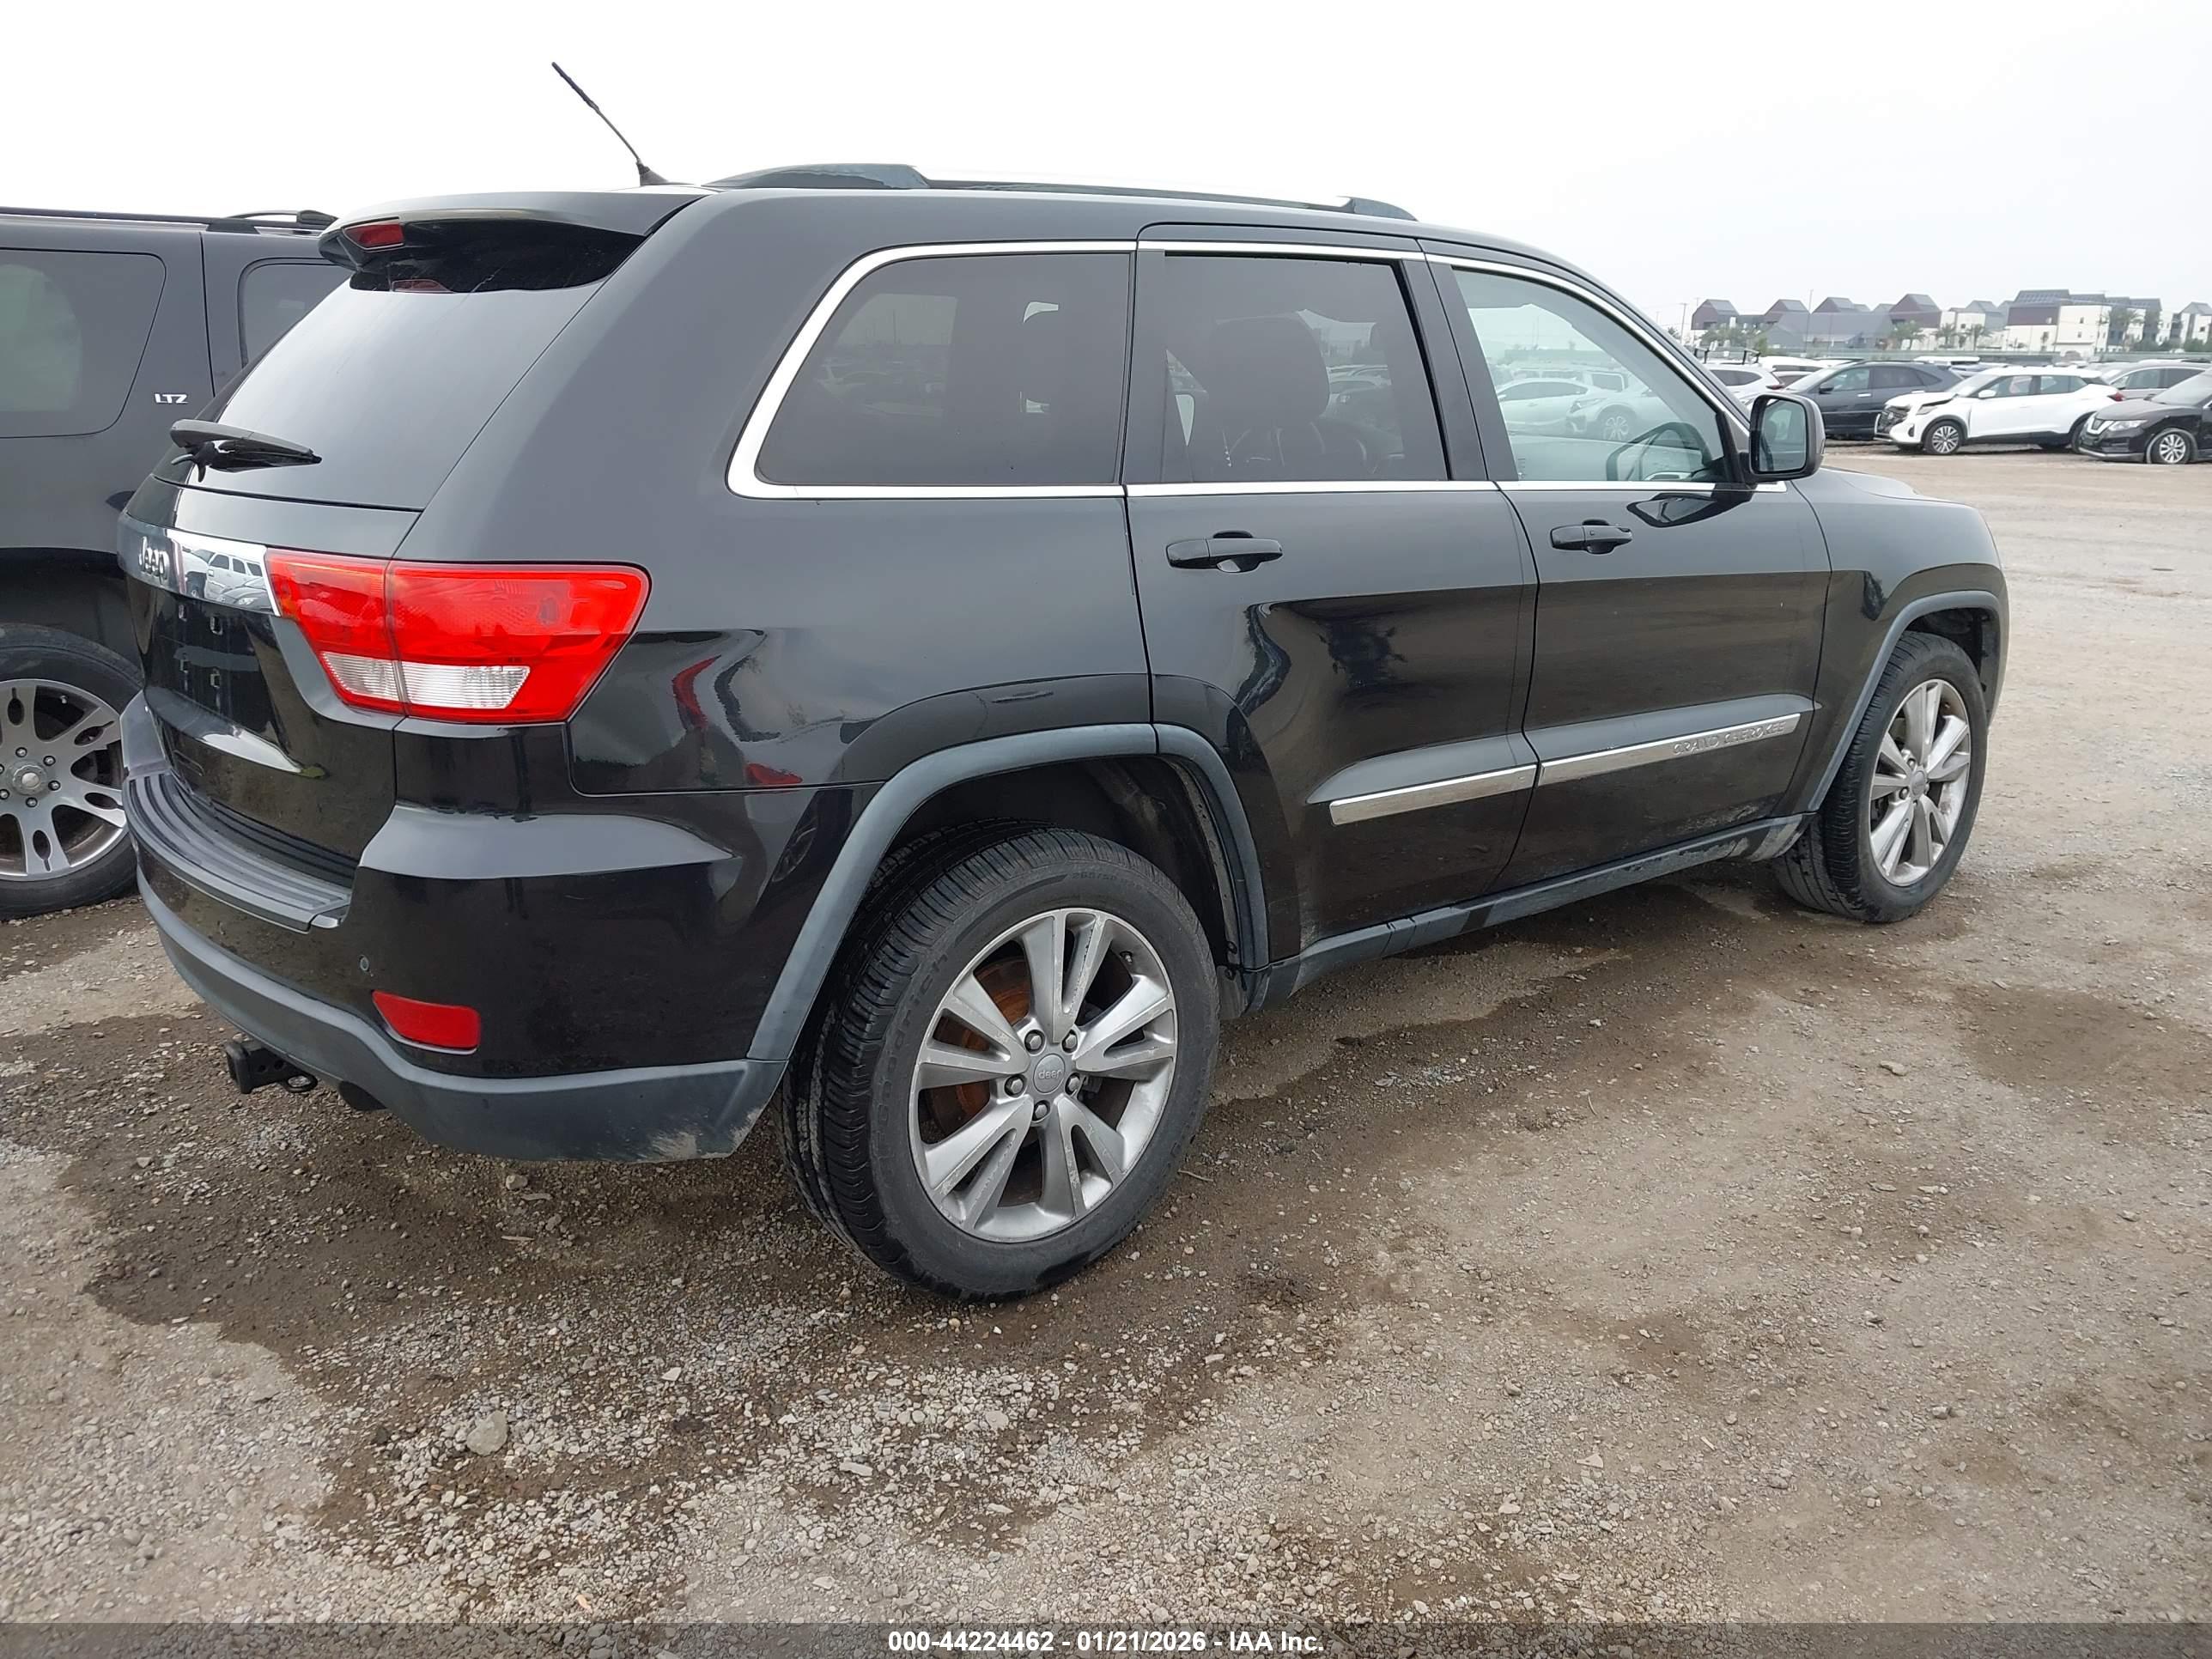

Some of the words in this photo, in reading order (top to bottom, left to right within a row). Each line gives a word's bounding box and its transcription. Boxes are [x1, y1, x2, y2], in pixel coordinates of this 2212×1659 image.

[155, 393, 189, 404] LTZ
[138, 536, 170, 585] Jeep
[1674, 734, 1720, 756] GRAND
[1724, 720, 1787, 744] CHEROKEE
[1037, 1069, 1063, 1080] Jeep
